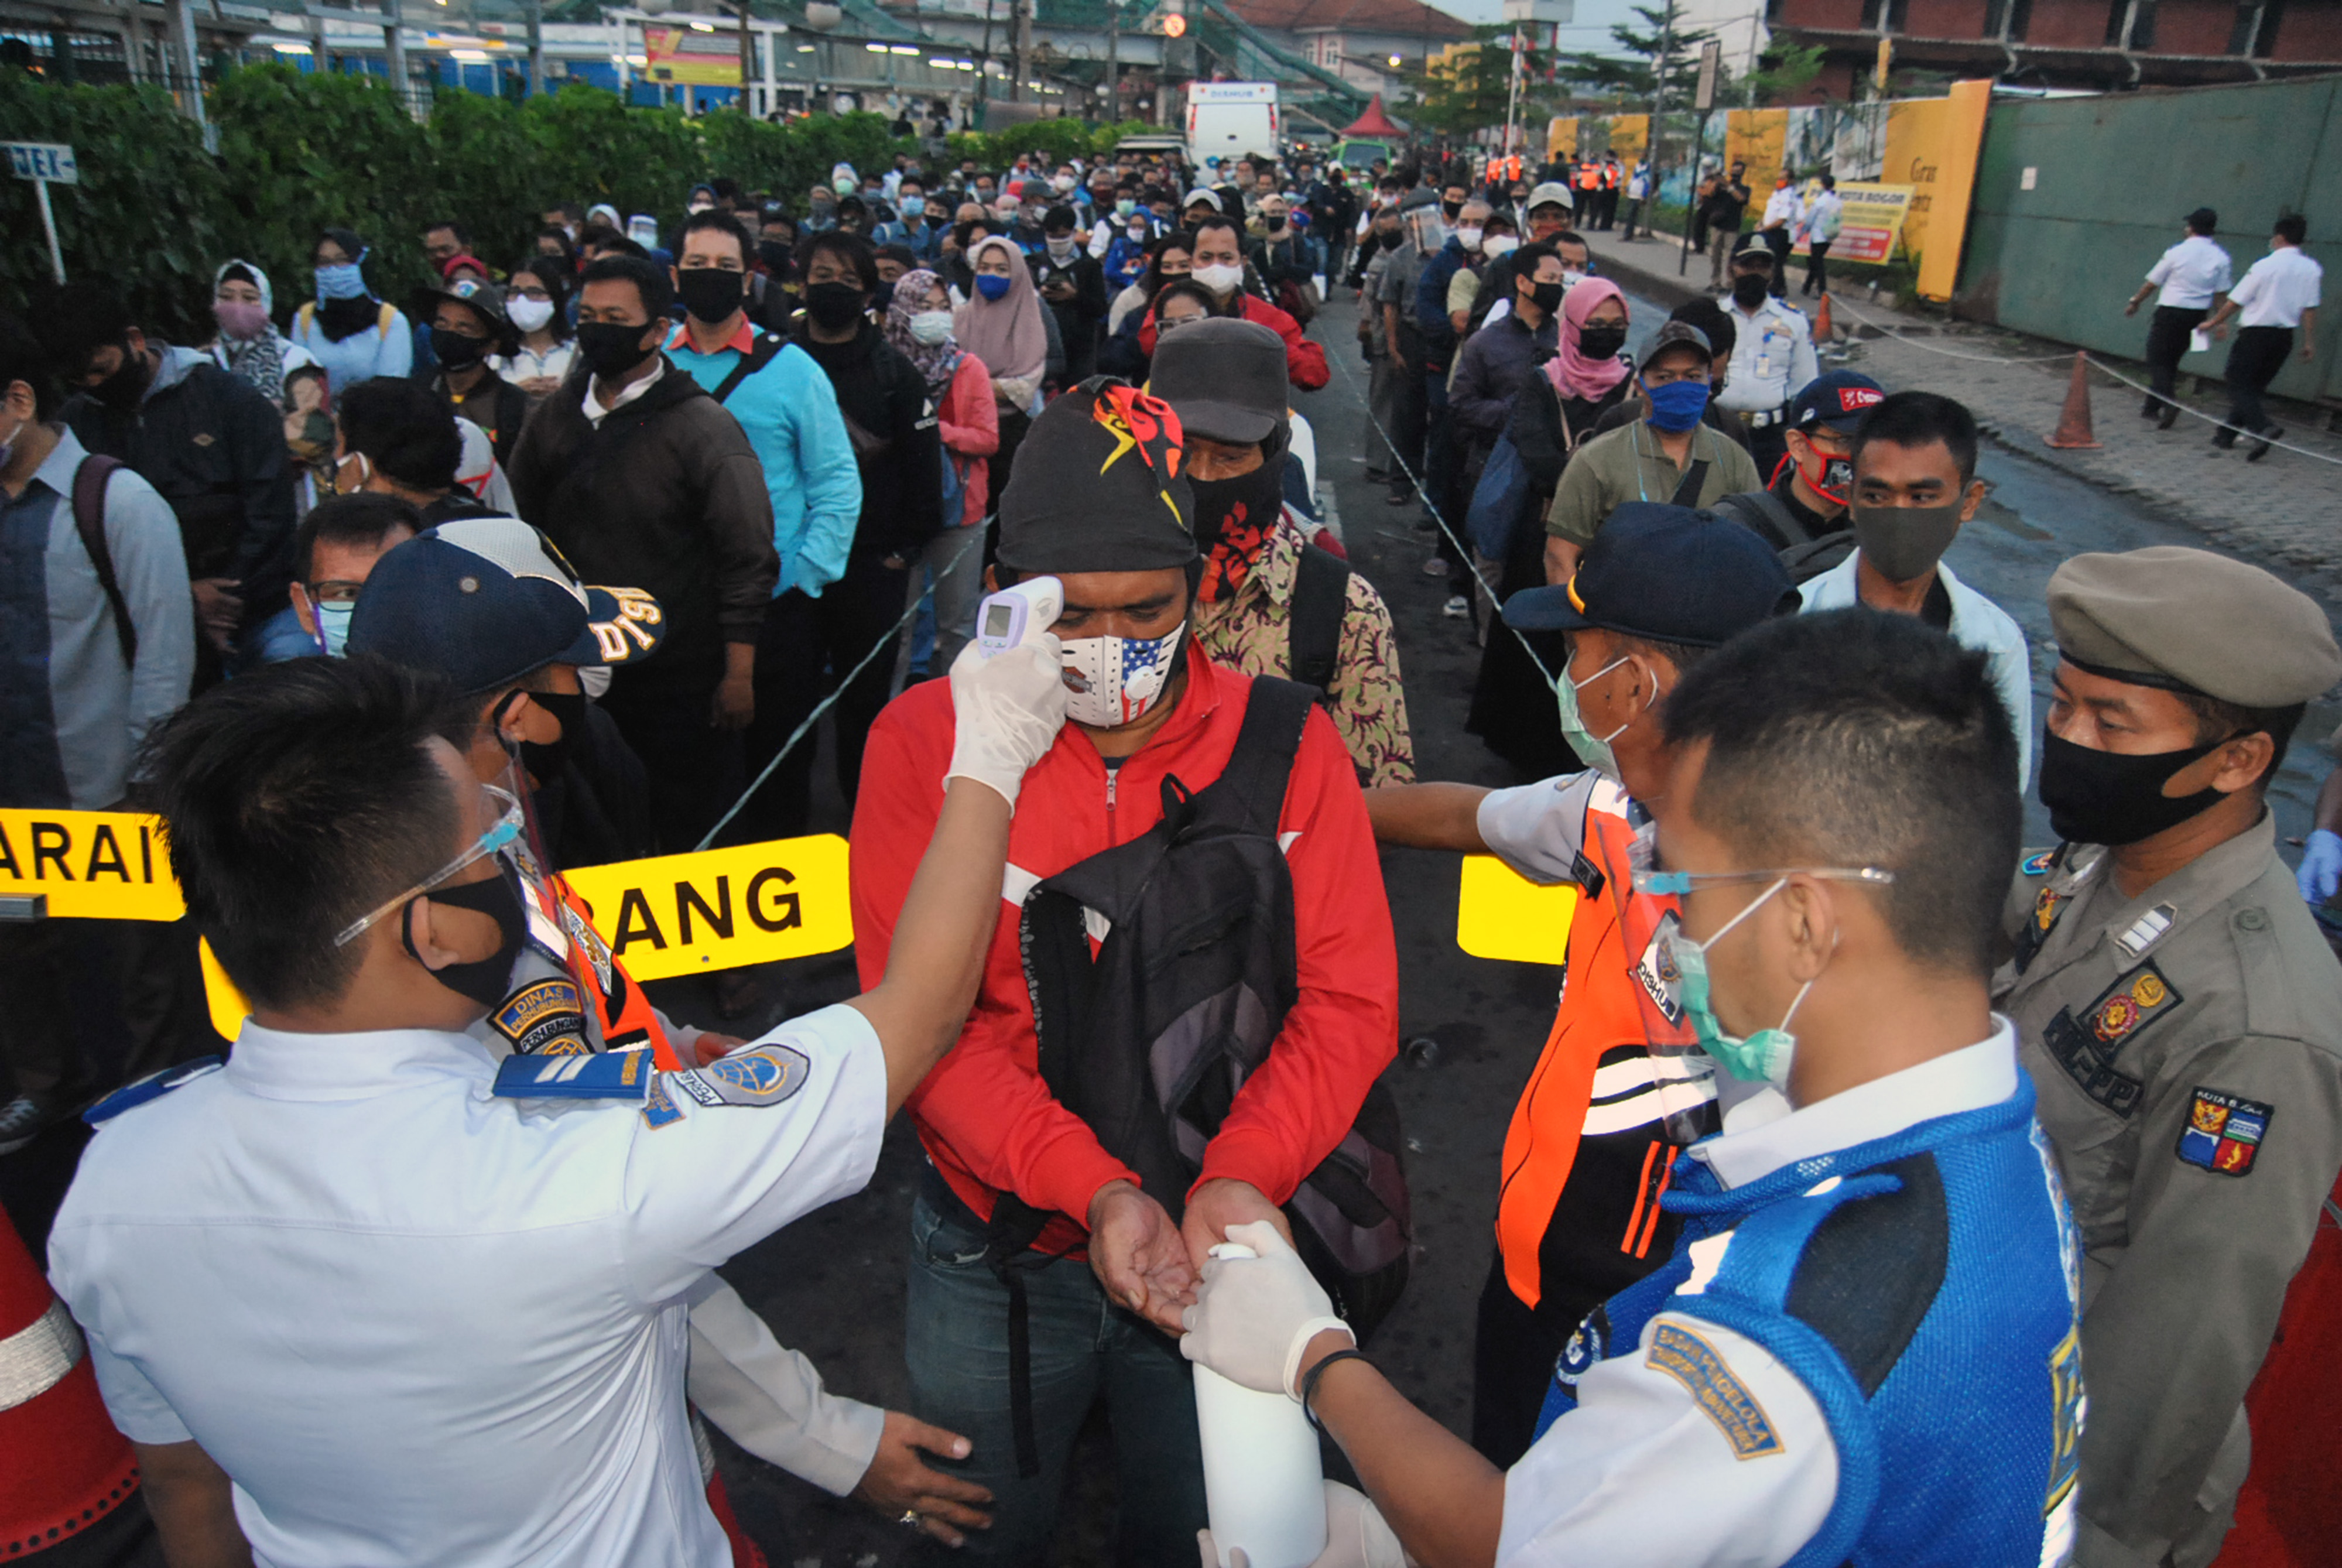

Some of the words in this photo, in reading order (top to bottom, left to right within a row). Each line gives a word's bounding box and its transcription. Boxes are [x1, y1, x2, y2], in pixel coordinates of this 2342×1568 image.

[1866, 192, 1905, 203] BOGOR
[580, 867, 802, 956] ANG
[514, 986, 564, 1014] DINAS
[2197, 1091, 2225, 1105] KOTA
